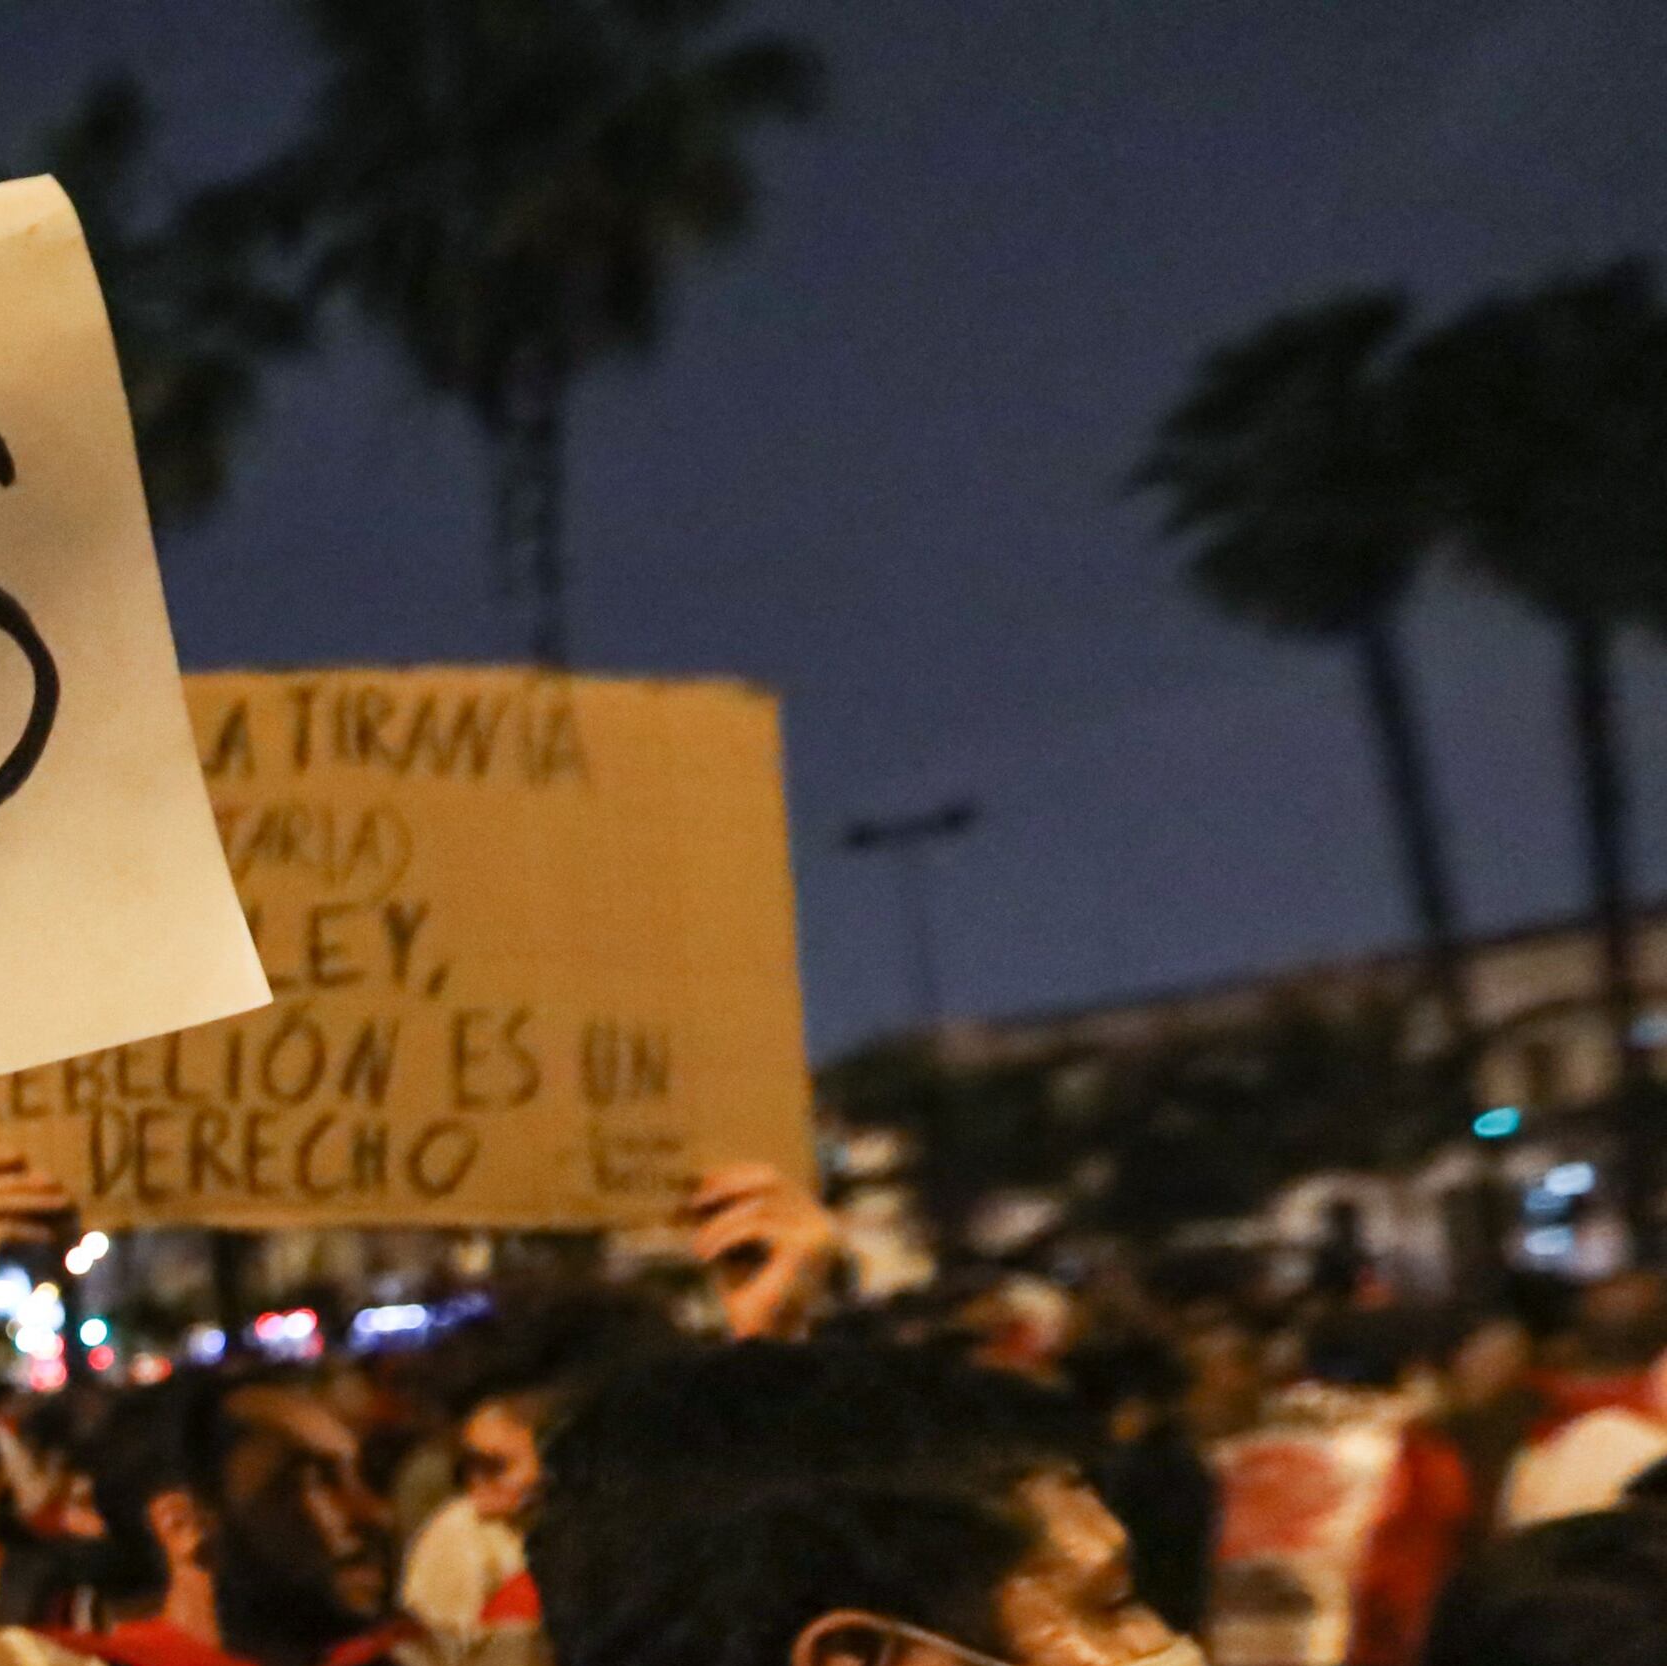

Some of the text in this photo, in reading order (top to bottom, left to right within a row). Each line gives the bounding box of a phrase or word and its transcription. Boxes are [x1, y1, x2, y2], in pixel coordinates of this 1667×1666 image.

[202, 694, 257, 780] A
[450, 1003, 542, 1110] ES
[579, 1014, 671, 1107] UN
[87, 1102, 481, 1205] DERECHO
